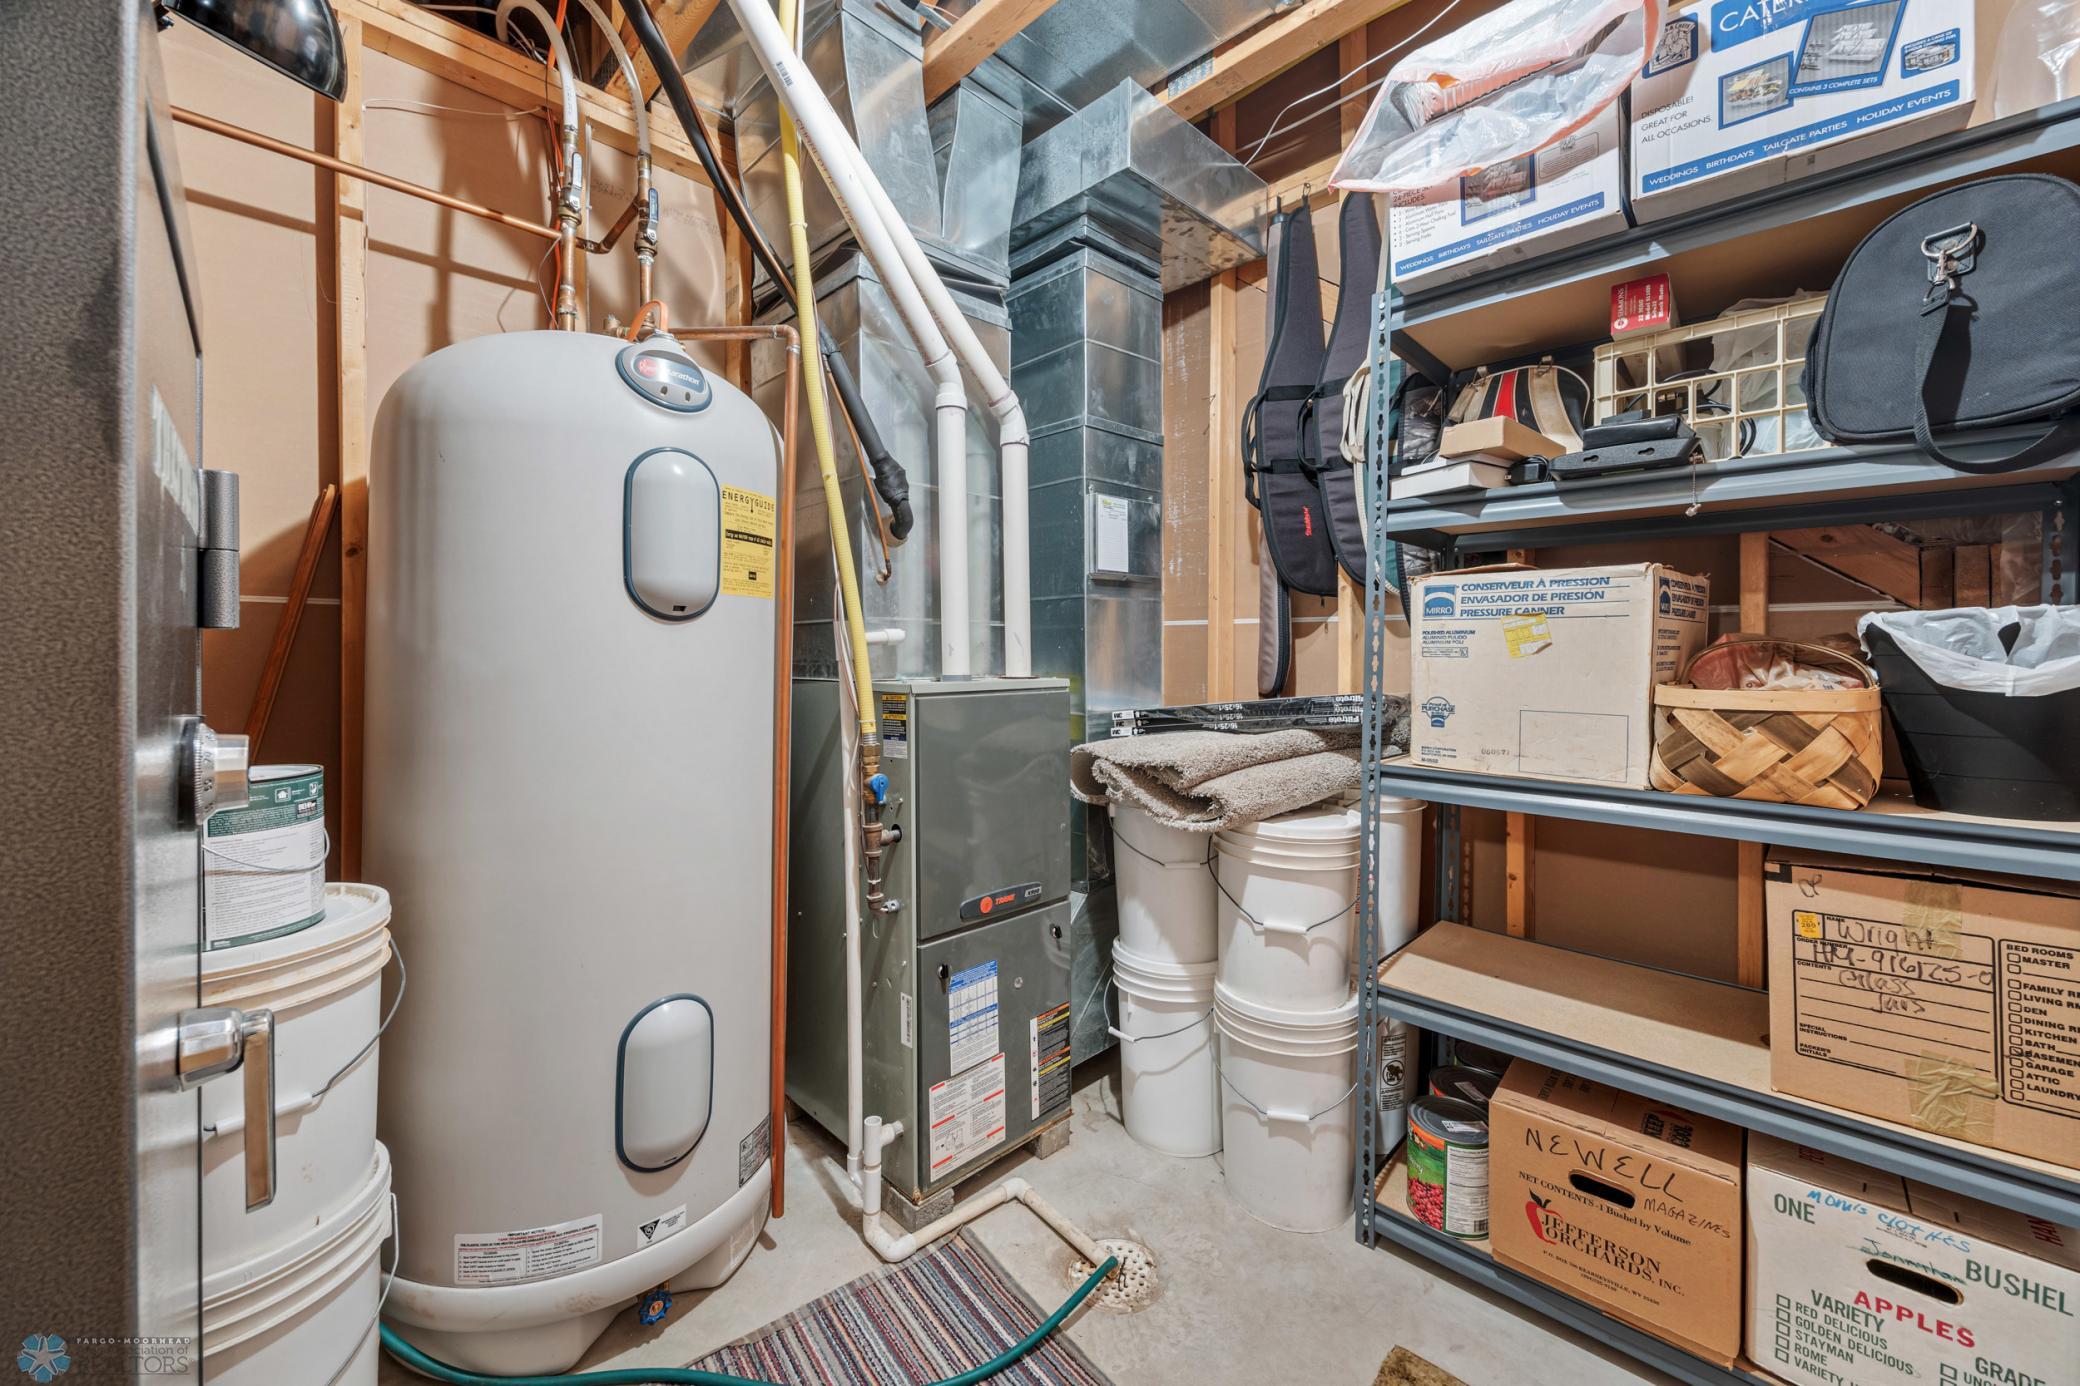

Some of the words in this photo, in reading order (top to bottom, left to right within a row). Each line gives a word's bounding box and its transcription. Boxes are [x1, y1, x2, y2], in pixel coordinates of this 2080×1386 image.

[1720, 0, 1806, 31] CATE
[1788, 85, 1823, 95] CONTAINS
[1828, 79, 1861, 88] COMPLETE
[1641, 116, 1669, 131] GREAT
[1670, 111, 1688, 121] FOR
[1642, 134, 1656, 144] ALL
[1649, 166, 1699, 186] WEDDINGS
[1706, 150, 1754, 169] BIRTHDAYS
[1762, 134, 1807, 152] TAILGATE
[1808, 121, 1848, 138] PARTIES
[1856, 104, 1904, 124] HOLIDAY
[1907, 89, 1952, 109] EVENTS
[1400, 255, 1434, 271] WEDDINGS
[1438, 243, 1471, 259] BIRTHDAYS
[1476, 231, 1506, 246] TAILGATE
[1507, 222, 1533, 235] PARTIES
[1537, 209, 1569, 225] HOLIDAY
[1571, 199, 1600, 214] EVENTS
[665, 369, 700, 385] arathon
[1461, 580, 1534, 592] CONSERVEUR
[1536, 578, 1546, 588] À
[1550, 577, 1610, 587] PRESSION
[1460, 594, 1529, 604] ENVASADOR
[1532, 593, 1548, 602] DE
[1550, 589, 1605, 601] PRESIÓN
[1426, 606, 1453, 615] MIRRO
[1460, 608, 1512, 617] PRESSURE
[1515, 606, 1565, 615] CANNER
[995, 894, 1016, 905] TRANE
[2006, 944, 2029, 953] BED
[2031, 947, 2074, 960] ROOMS
[1797, 960, 1832, 970] CONTENTS
[2022, 956, 2071, 970] MASTER
[2023, 983, 2065, 996] FAMILY
[2023, 993, 2063, 1007] LIVING
[2024, 1006, 2047, 1016] DEN
[1800, 1023, 1826, 1032] SPECIAL
[2024, 1017, 2065, 1031] DINING
[1800, 1028, 1847, 1041] INSTRUCTIONS
[2024, 1028, 2077, 1044] KITCHEN
[1800, 1048, 1827, 1057] INITIALS
[2024, 1040, 2056, 1051] BATH
[2025, 1051, 2080, 1067] BASEMEN
[2026, 1062, 2075, 1077] GARAGE
[2026, 1073, 2060, 1085] ATTIC
[2027, 1084, 2080, 1101] LAUNDRY
[1525, 1128, 1684, 1202] NEWELL
[1519, 1171, 1538, 1184] NET
[1540, 1179, 1594, 1206] CONTENTS
[1606, 1207, 1637, 1225] Bushel
[1639, 1219, 1651, 1232] by
[1654, 1224, 1692, 1246] Volume
[1774, 1193, 1816, 1225] ONE
[1644, 1198, 1731, 1239] MAGAZINES
[1541, 1213, 1662, 1274] JEFFERSON
[1659, 1279, 1686, 1297] INC.
[1965, 1259, 2074, 1317] BUSHEL
[1811, 1289, 1885, 1333] VARIETY
[1853, 1290, 1976, 1348] APPLES
[1796, 1301, 1818, 1319] RED
[1824, 1311, 1888, 1350] DELICIOUS
[1795, 1315, 1842, 1345] GOLDEN
[1848, 1338, 1914, 1376] DELICIOUS
[1795, 1330, 1854, 1364] STAYMAN
[1794, 1343, 1828, 1367] ROME
[1794, 1356, 1844, 1386] VARIETY
[1975, 1357, 2046, 1386] GRAD
